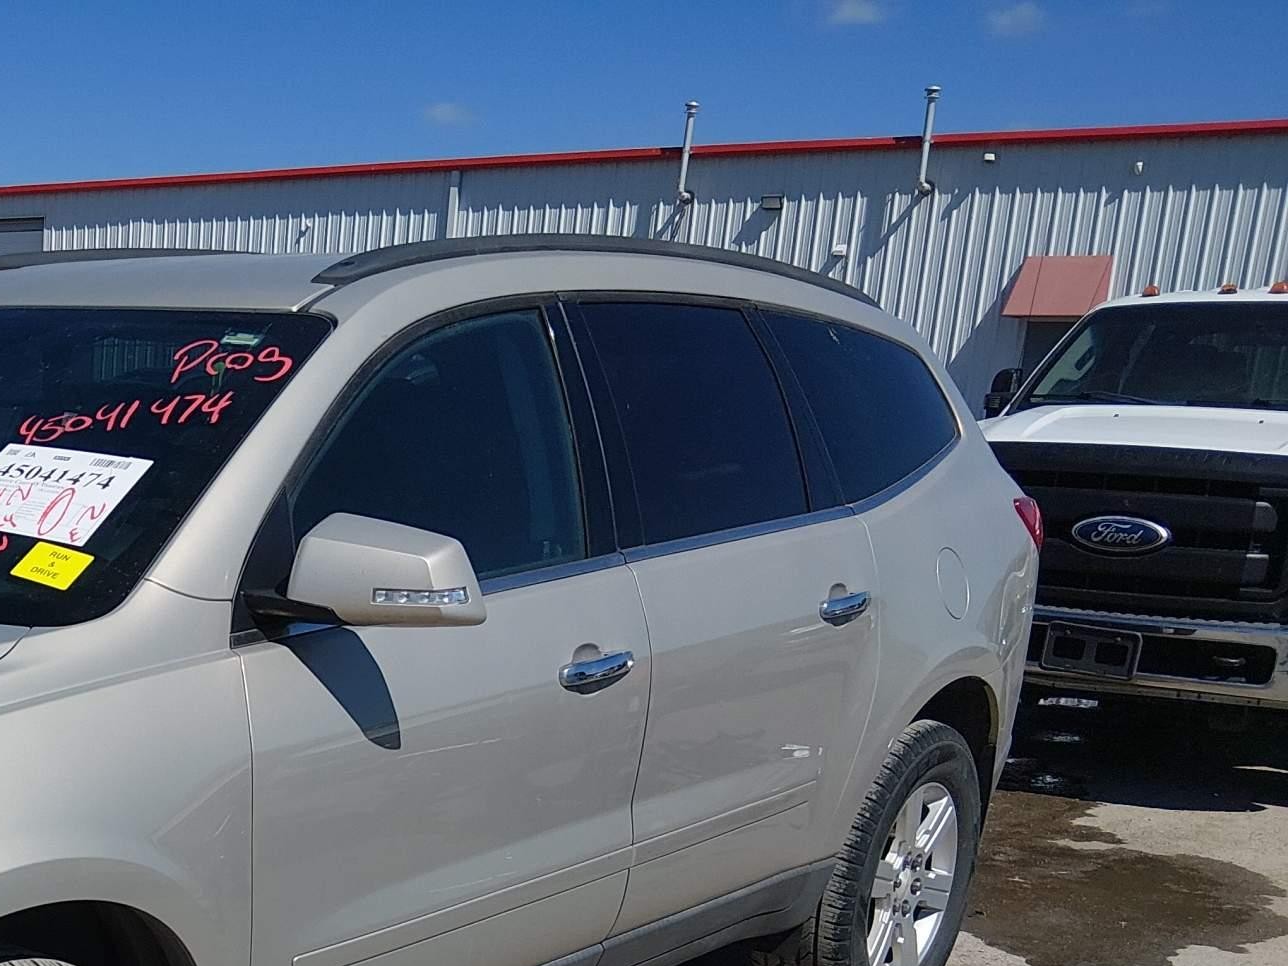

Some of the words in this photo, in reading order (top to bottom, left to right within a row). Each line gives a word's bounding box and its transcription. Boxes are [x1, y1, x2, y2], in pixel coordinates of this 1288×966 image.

[1090, 522, 1144, 545] Ford
[48, 551, 71, 561] RUN
[30, 566, 60, 579] DRIVE
